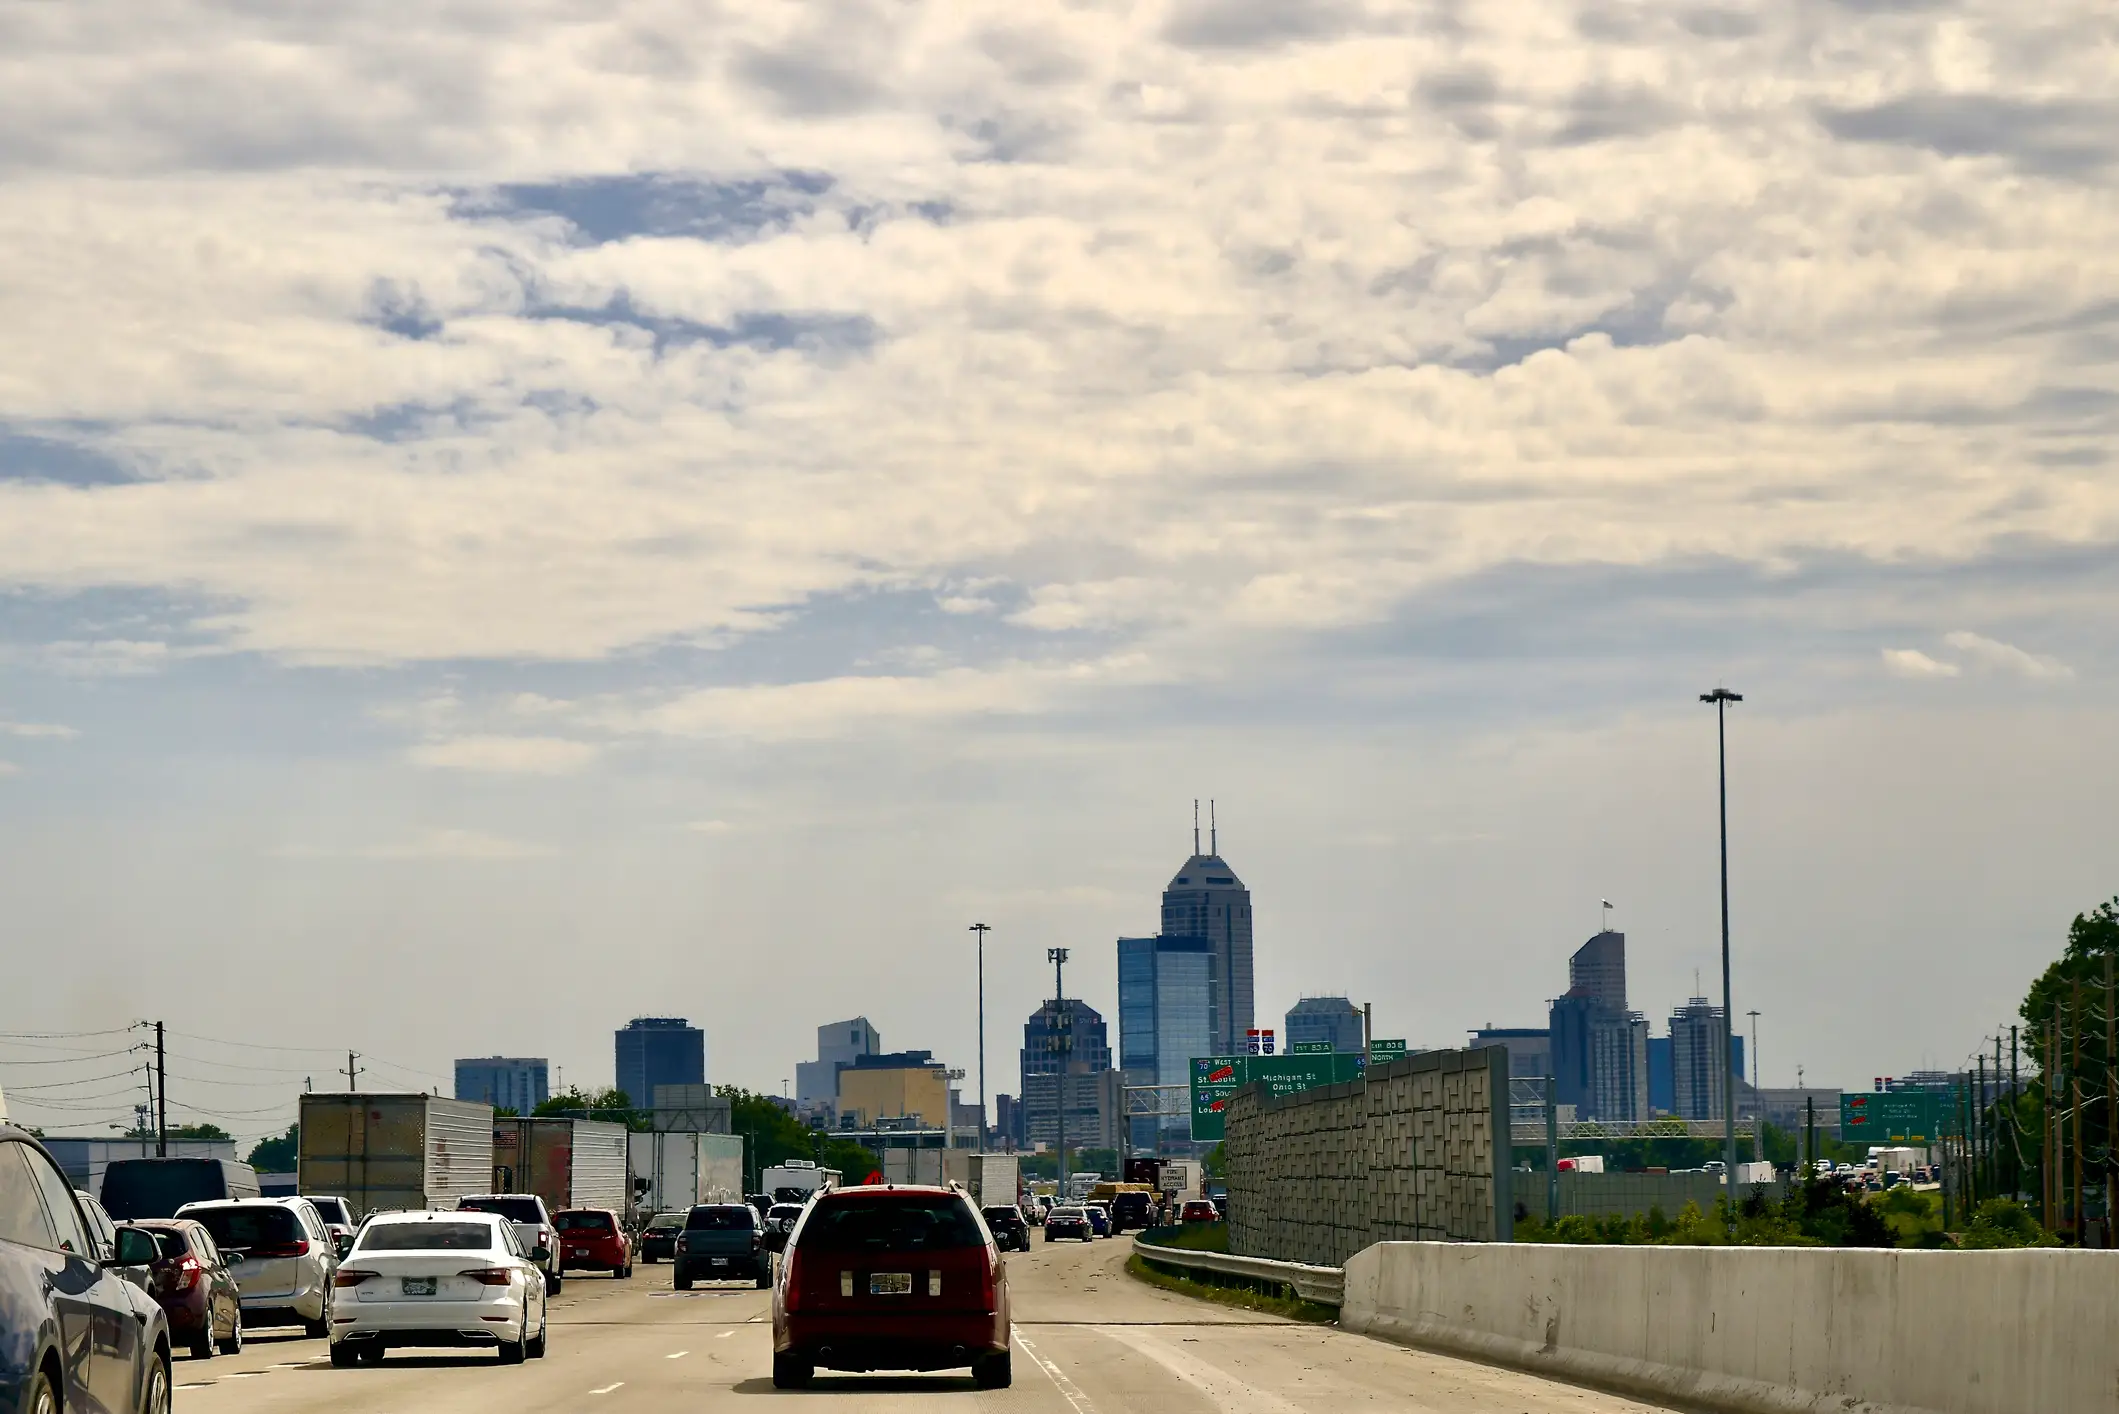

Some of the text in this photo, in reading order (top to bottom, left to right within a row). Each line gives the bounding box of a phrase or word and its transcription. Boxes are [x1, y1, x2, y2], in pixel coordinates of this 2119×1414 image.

[1197, 1076, 1209, 1084] St.
[1262, 1074, 1302, 1082] Michigan
[1272, 1082, 1306, 1091] Ohio St
